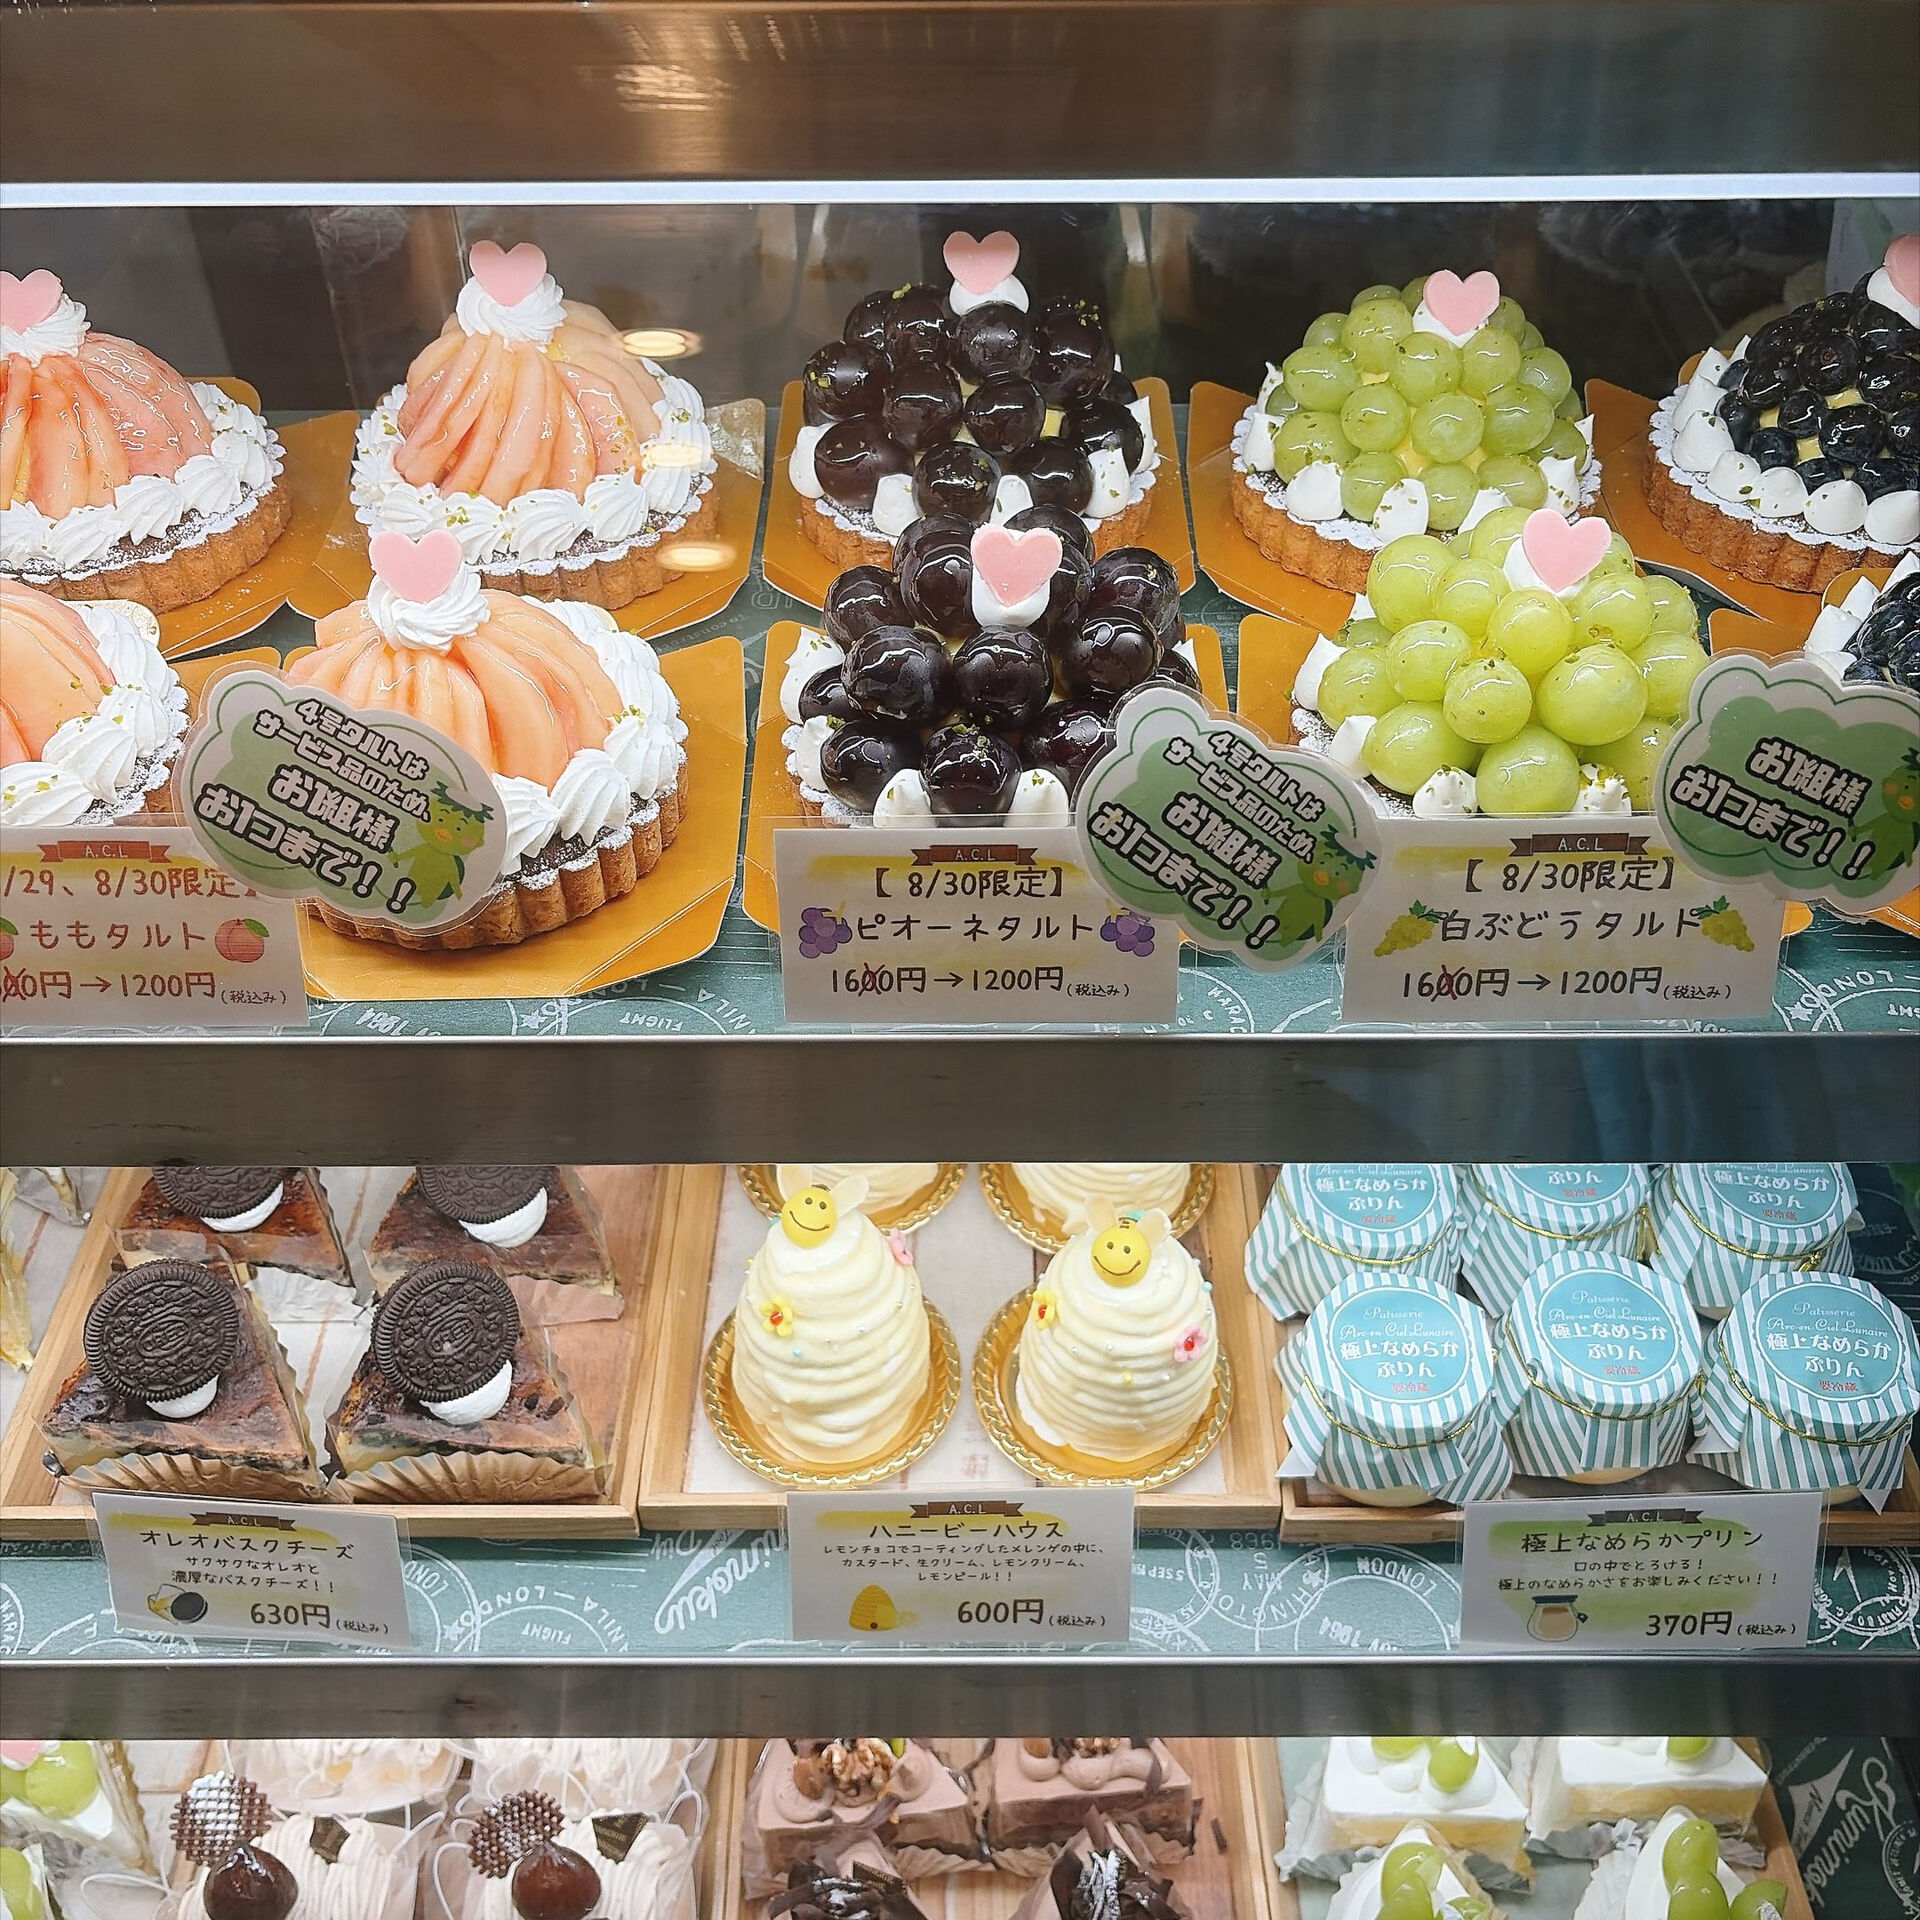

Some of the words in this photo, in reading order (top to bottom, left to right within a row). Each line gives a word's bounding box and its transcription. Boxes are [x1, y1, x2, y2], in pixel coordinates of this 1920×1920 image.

[296, 699, 429, 780] 4号タルトは
[253, 709, 432, 823] サービス品のため、
[1208, 731, 1327, 822] 4号タルトは
[1745, 737, 1872, 817] お1組様
[268, 765, 401, 852] お1組様
[1162, 737, 1321, 864] サービス品のため、
[1162, 791, 1282, 889] お1組様
[1558, 837, 1604, 851] A.C.L
[85, 846, 128, 859] A.C.L
[955, 848, 997, 862] A.C.L
[29, 919, 206, 950] ももタルト
[857, 913, 1094, 942] ピオーネタルト
[120, 971, 216, 999] 1200円
[973, 966, 1064, 993] 1200円
[1560, 966, 1663, 995] 1200円
[619, 1011, 683, 1032] FLIGHT
[1315, 1176, 1428, 1193] 極上なめらか
[1713, 1169, 1829, 1192] 極上なめらか
[1549, 1322, 1667, 1341] 極上なめらか
[1339, 1339, 1459, 1361] 極上なめらか
[1766, 1332, 1892, 1361] 極上なめらか
[1805, 1355, 1864, 1378] ぷりん
[949, 1503, 987, 1515] A.C.L
[869, 1521, 1064, 1539] ハニービーハウス
[1521, 1528, 1763, 1554] 極上なめらかプリン
[139, 1530, 355, 1560] オレオバスクチーズ
[824, 1542, 1104, 1554] レモンチョコでコーティングしたメレンゲの中に、
[185, 1556, 321, 1575] サクサクなオレオと
[841, 1557, 1085, 1569] カスタード、生クリーム、レモンクリーム、
[1574, 1558, 1703, 1573] 口の中でとろける！
[171, 1570, 335, 1593] 濃厚なバスクチーズ！！
[917, 1570, 1013, 1582] レモンピール！！
[1498, 1573, 1779, 1592] 極上のなめらかさをお楽しみください！！
[250, 1603, 331, 1629] 630円
[958, 1598, 1044, 1624] 600円
[521, 1621, 573, 1645] FLIGHT
[1645, 1610, 1733, 1637] 370円
